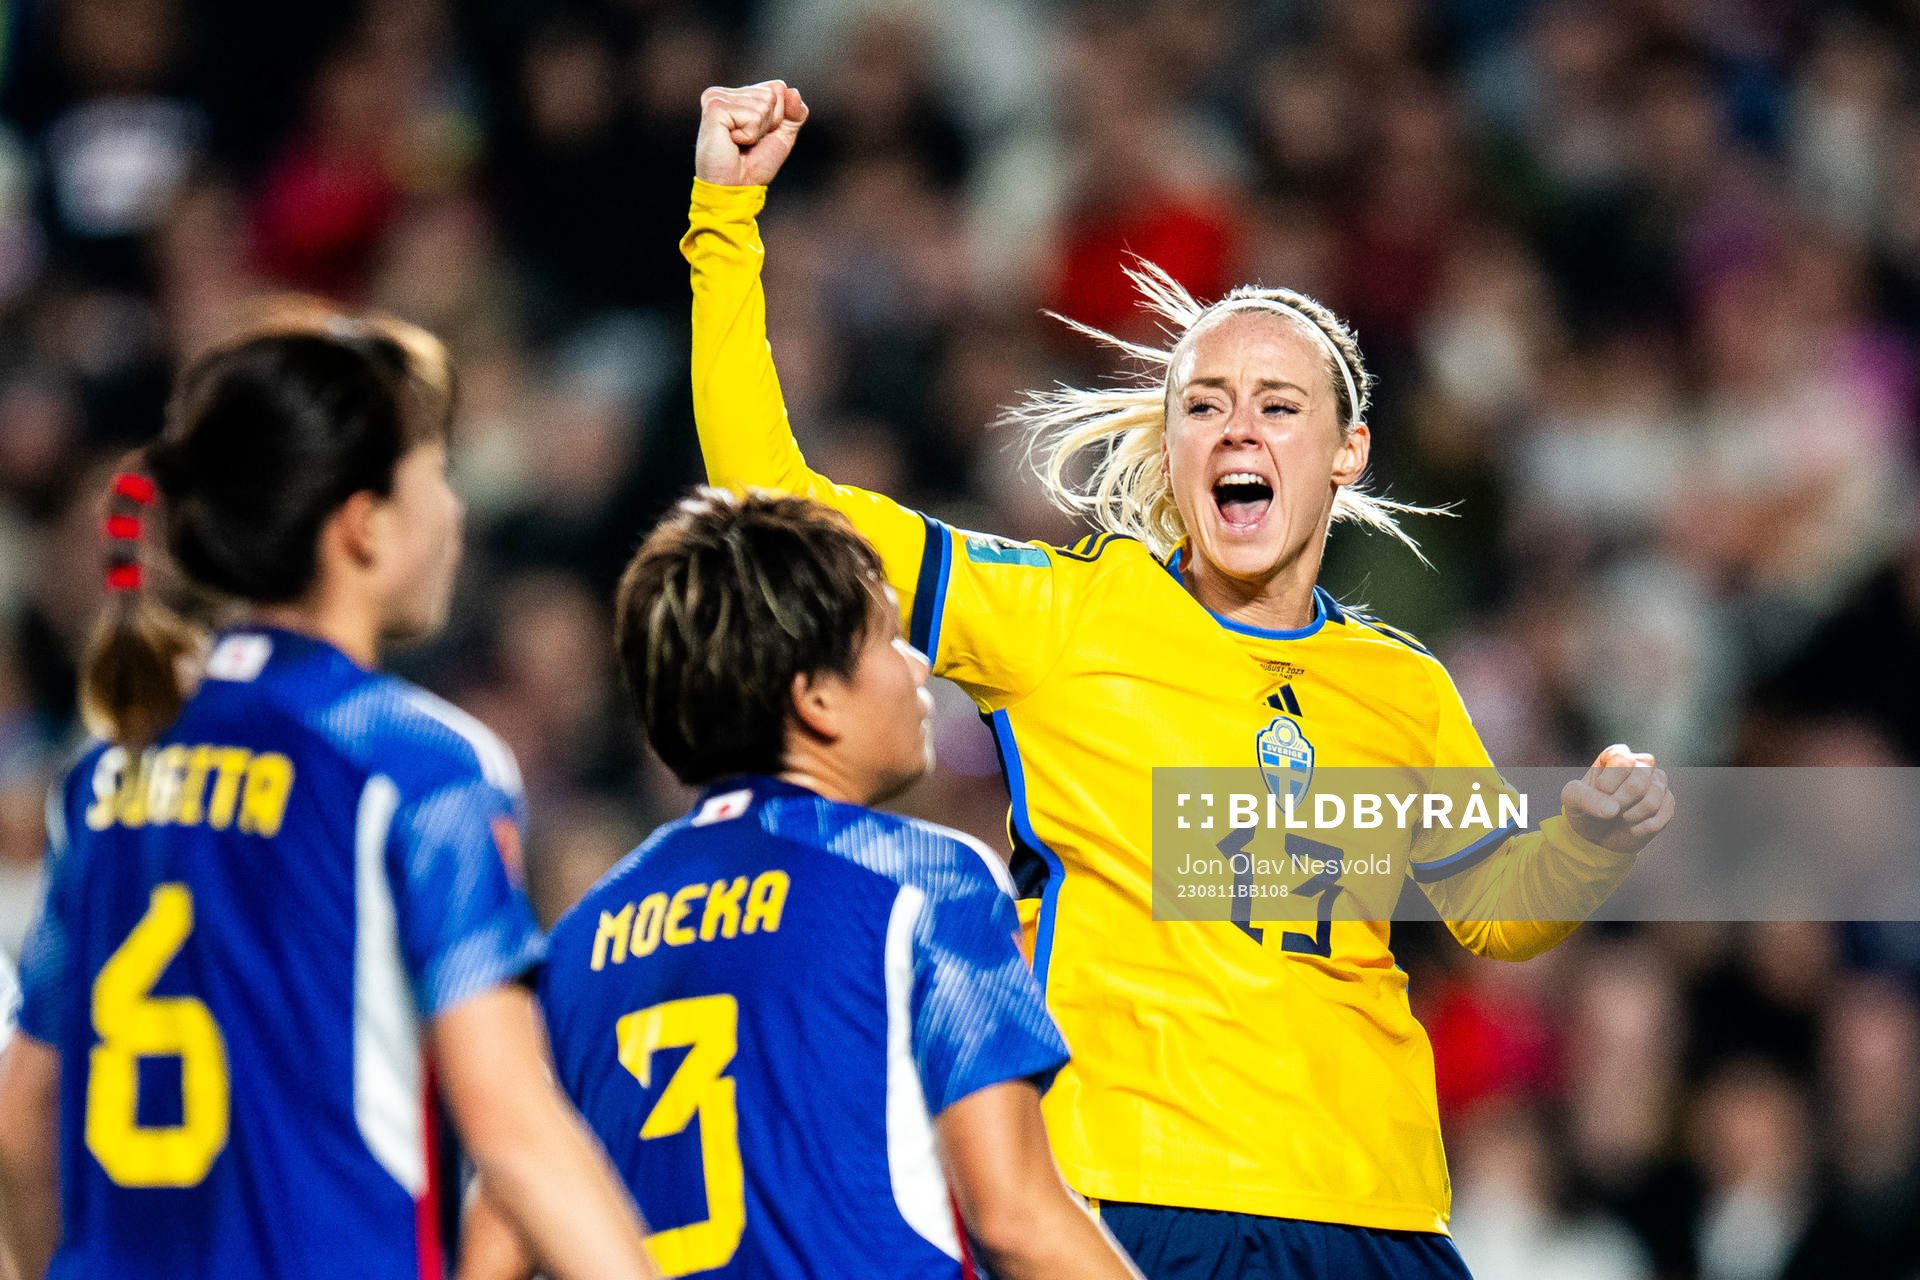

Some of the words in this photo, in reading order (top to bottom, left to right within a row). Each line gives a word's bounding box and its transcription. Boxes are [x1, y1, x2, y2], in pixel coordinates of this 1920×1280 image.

[590, 869, 790, 972] MOEKA
[1216, 820, 1345, 959] 13
[85, 882, 231, 1188] 6
[615, 993, 747, 1278] 3
